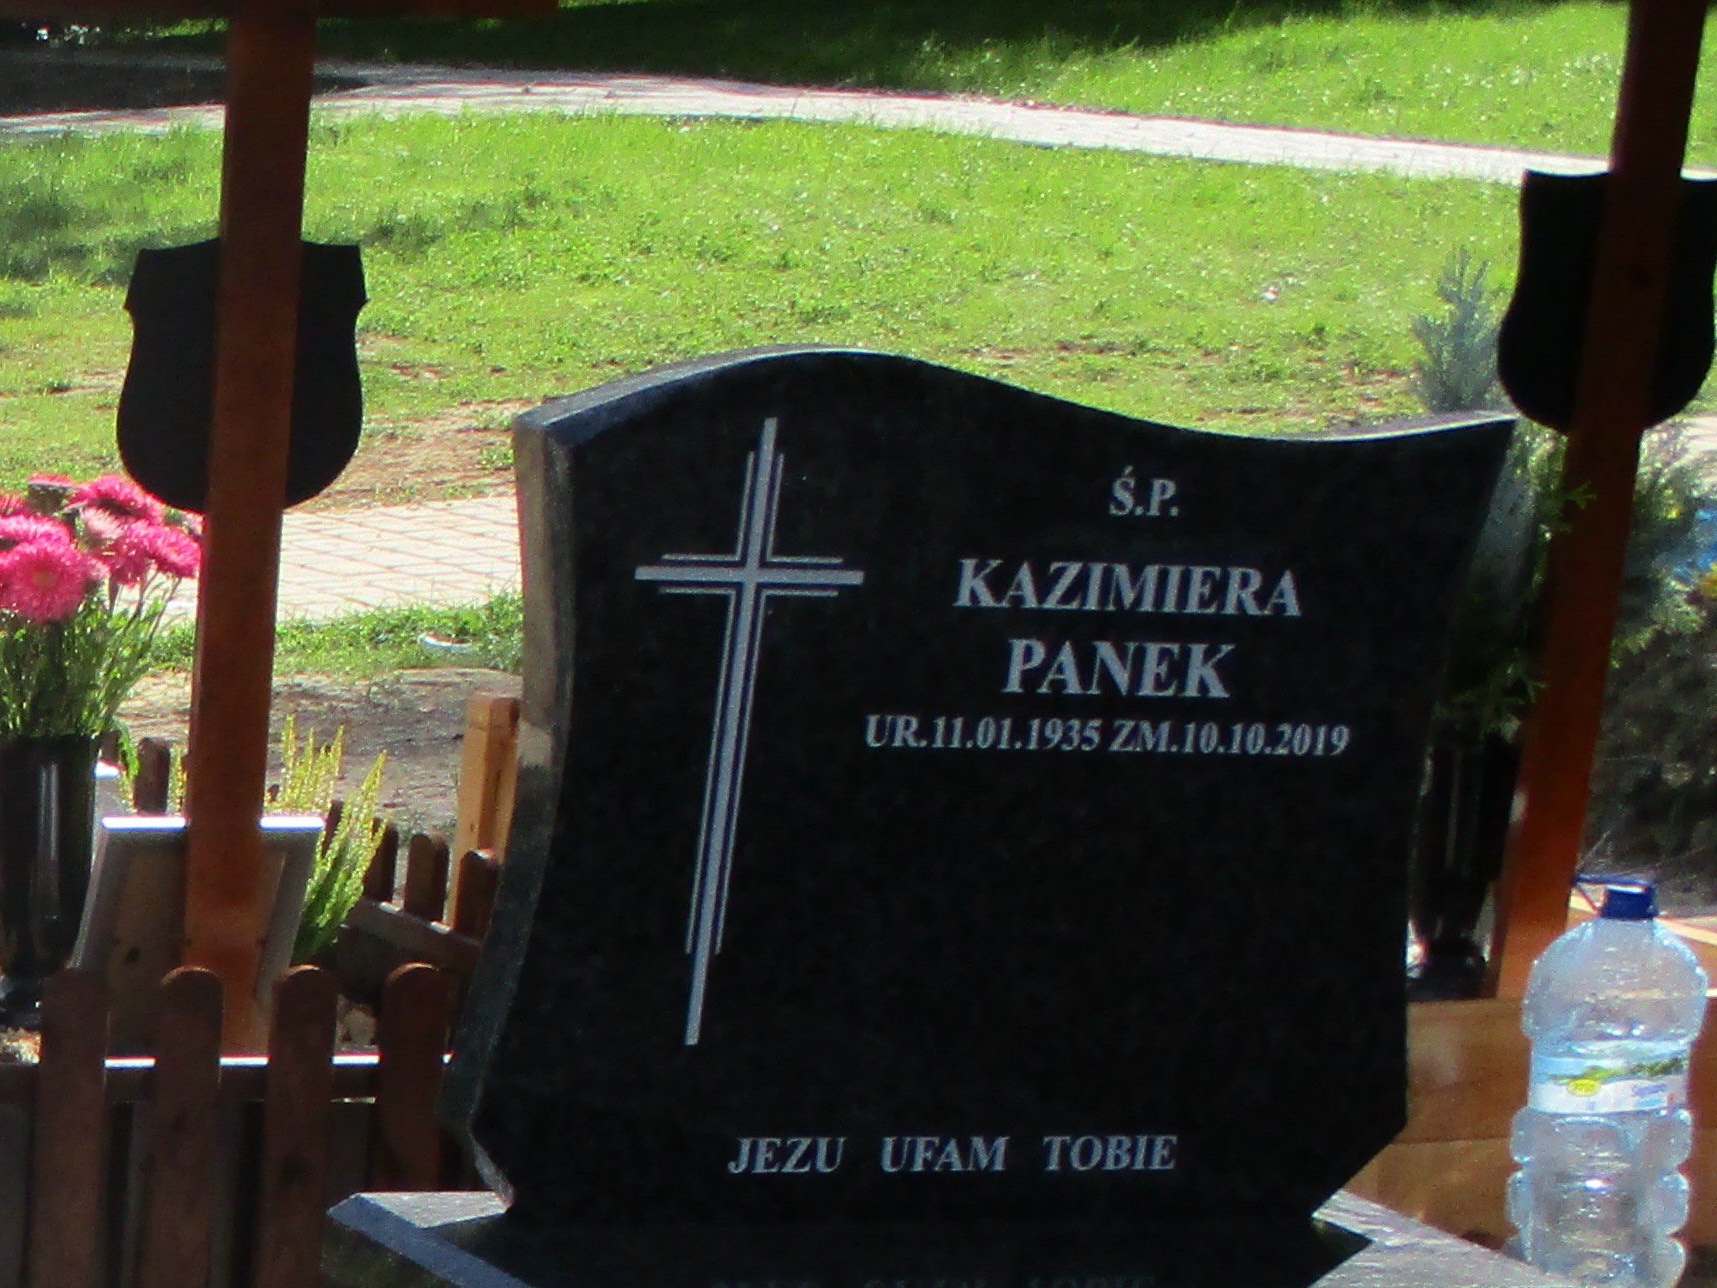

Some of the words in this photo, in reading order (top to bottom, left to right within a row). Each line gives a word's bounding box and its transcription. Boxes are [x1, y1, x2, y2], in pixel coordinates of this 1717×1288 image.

[952, 557, 1303, 618] KAZIMIERA
[1000, 637, 1237, 699] PANEK
[728, 1136, 847, 1174] JEZU
[879, 1135, 1011, 1173] UFAM
[1042, 1134, 1180, 1171] TOBIE
